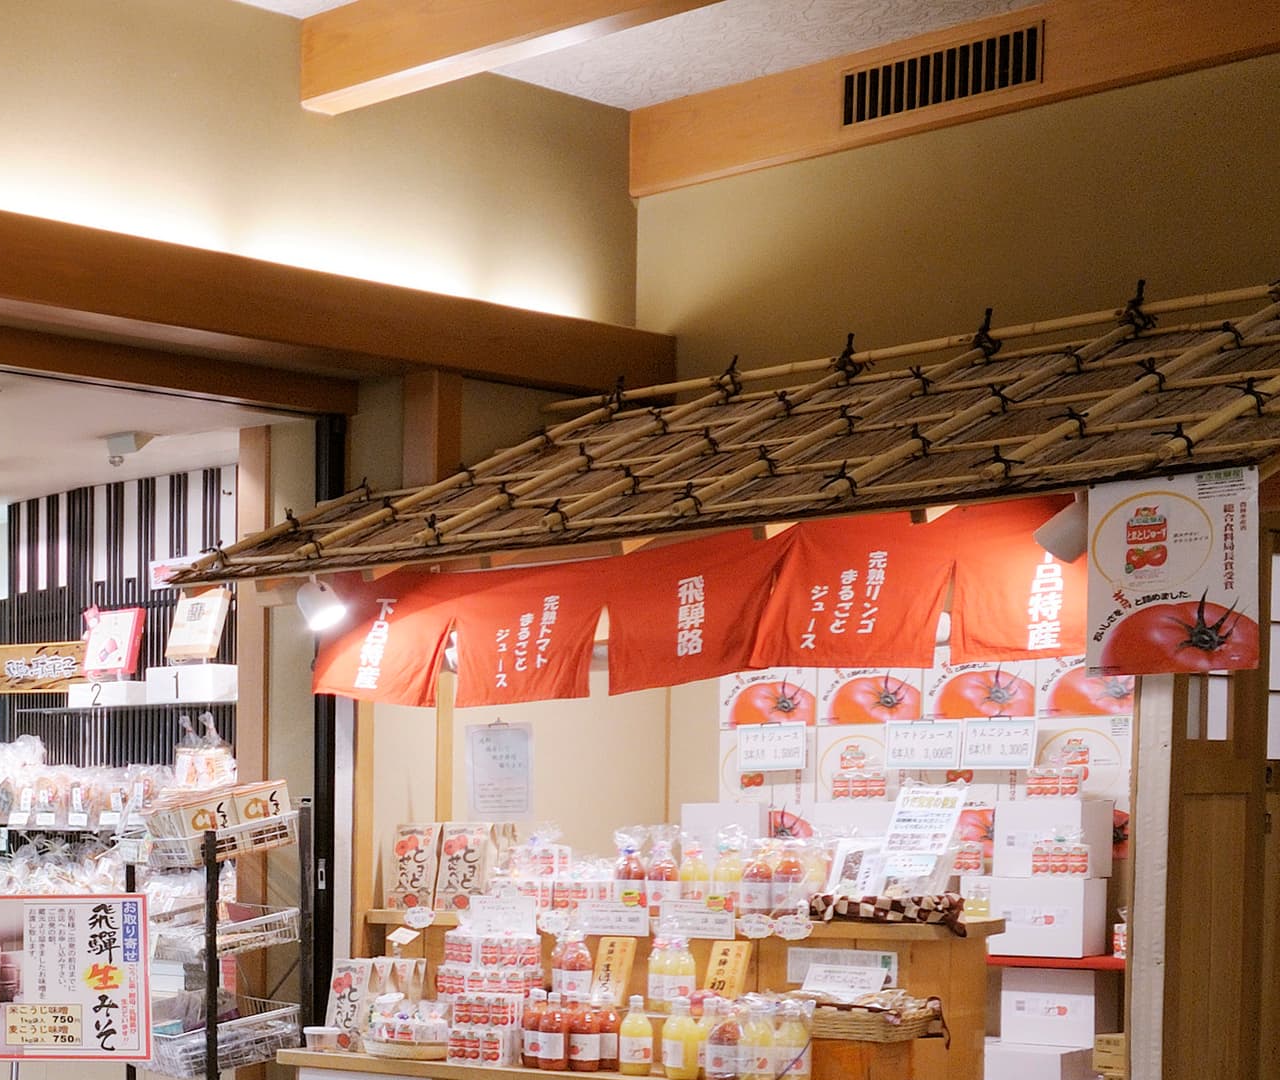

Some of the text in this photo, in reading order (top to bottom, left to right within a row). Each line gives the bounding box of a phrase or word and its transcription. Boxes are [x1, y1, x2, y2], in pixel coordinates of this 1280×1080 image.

[676, 574, 706, 657] 飛騨路
[800, 585, 828, 649] ジュース
[829, 569, 858, 634] まるごと
[856, 550, 888, 634] 完熟リンゴ
[354, 597, 397, 690] 下呂特産
[494, 629, 510, 688] ジュース
[514, 612, 535, 672] まるごと
[535, 595, 561, 669] 完熟トマト
[91, 683, 102, 706] 2
[122, 901, 139, 962] お取り寄せ
